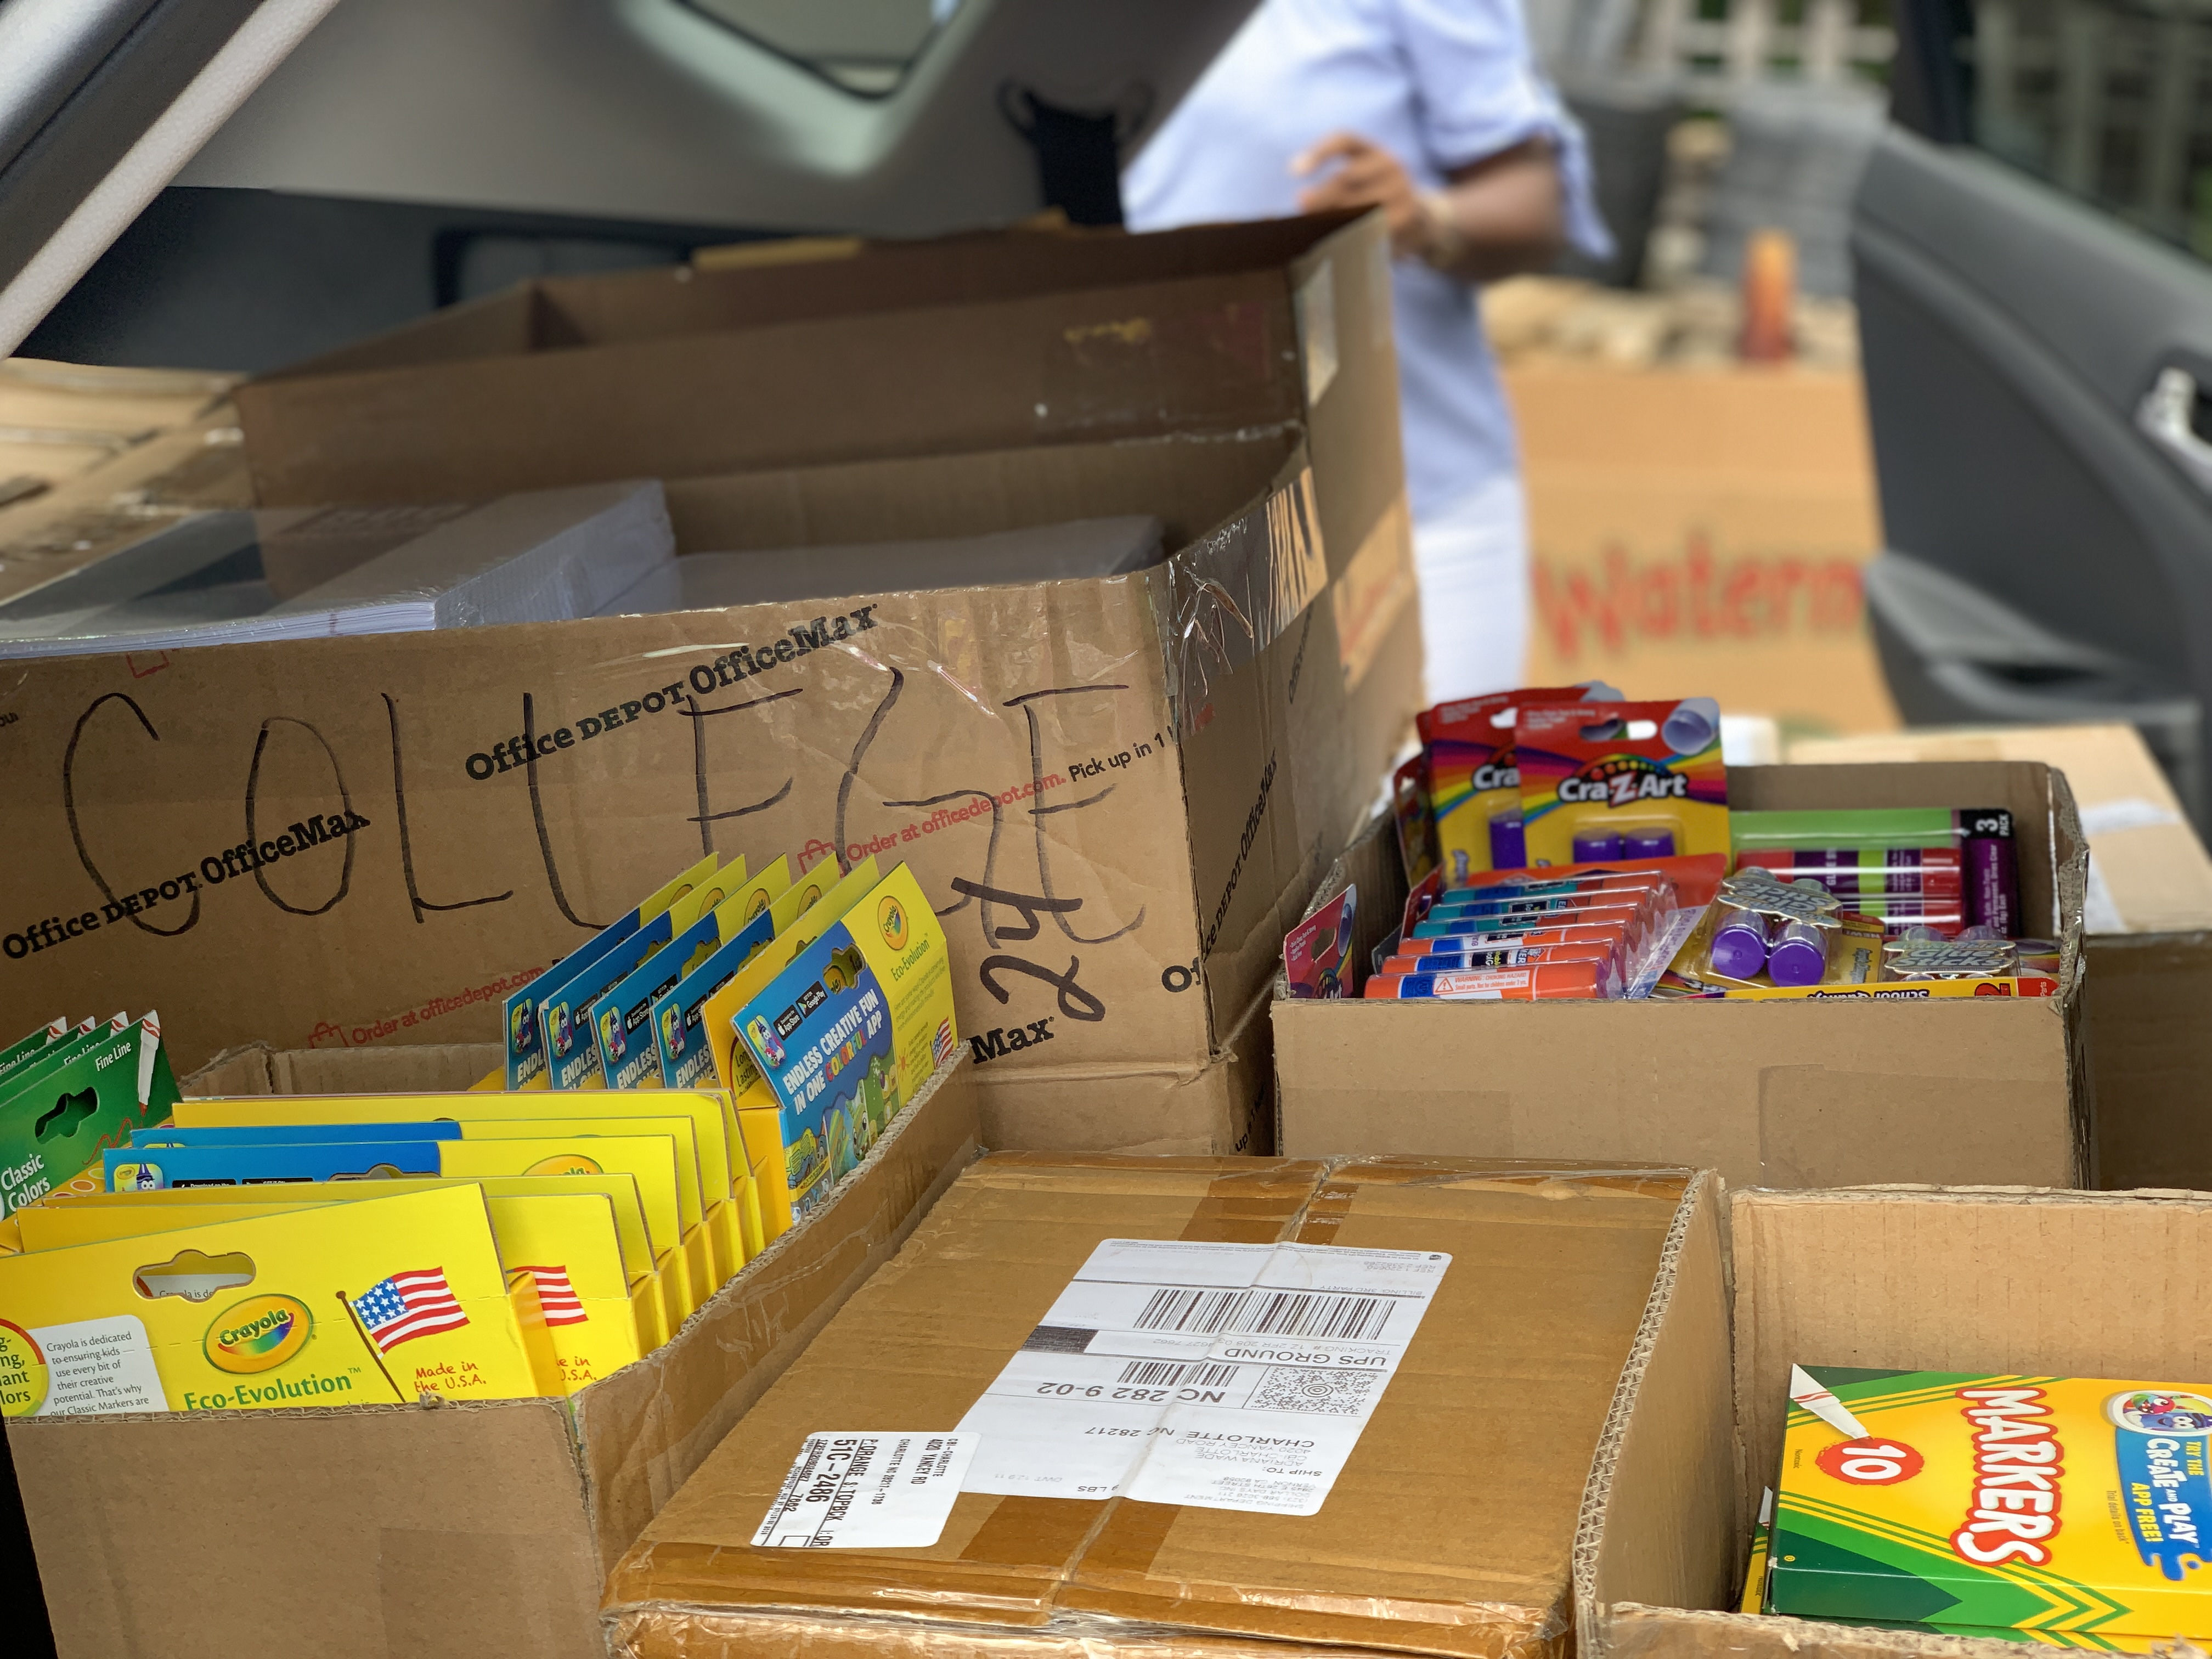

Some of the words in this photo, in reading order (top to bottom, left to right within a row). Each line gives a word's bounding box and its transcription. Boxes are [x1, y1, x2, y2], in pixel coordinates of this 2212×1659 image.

[465, 725, 576, 780] Office
[577, 680, 686, 741] DEPOT
[689, 603, 879, 695] OfficeMax
[847, 827, 897, 861] Order
[901, 826, 919, 843] at
[1069, 757, 1106, 783] Pick
[1108, 751, 1132, 771] up
[1133, 742, 1152, 758] in
[1154, 732, 1165, 748] 1
[1976, 819, 1998, 832] 3
[1999, 814, 2009, 837] PACK
[3, 911, 101, 959] Office
[105, 872, 202, 924] DEPOT
[201, 810, 371, 885] OfficeMax
[1216, 853, 1243, 932] DEPOT
[352, 1019, 398, 1044] Order
[401, 1011, 420, 1028] at
[782, 1046, 823, 1095] ENDLESS
[820, 1006, 863, 1056] CREATIVE
[858, 989, 879, 1013] FUN
[95, 1052, 114, 1071] Fine
[114, 1041, 132, 1061] Line
[561, 1043, 597, 1087] ENDLES
[794, 1092, 806, 1115] IN
[806, 1074, 826, 1102] ONE
[825, 1028, 867, 1082] COLORFUL
[866, 1010, 882, 1039] APP
[1, 1153, 45, 1191] Classic
[8, 1176, 50, 1212] Colors
[219, 1309, 289, 1346] Crayola
[47, 1340, 80, 1353] Crayola
[81, 1339, 88, 1347] is
[89, 1331, 132, 1346] dedicated
[1153, 1338, 1182, 1346] 7662
[1324, 1345, 1391, 1355] TRACKING
[52, 1357, 61, 1365] to
[64, 1350, 100, 1364] ensuring
[102, 1347, 120, 1358] kids
[574, 1356, 591, 1367] in
[1224, 1347, 1331, 1364] GROUND
[1340, 1355, 1387, 1367] UPS
[56, 1369, 71, 1378] use
[72, 1365, 97, 1378] every
[98, 1362, 110, 1371] bit
[112, 1359, 121, 1370] of
[415, 1362, 456, 1380] Made
[461, 1361, 479, 1373] in
[58, 1380, 78, 1390] their
[80, 1375, 114, 1387] creative
[413, 1380, 440, 1393] the
[445, 1374, 487, 1390] U.S.A.
[1036, 1381, 1104, 1398] 9-02
[54, 1390, 95, 1407] potential.
[95, 1386, 123, 1399] That's
[124, 1384, 142, 1396] why
[1111, 1387, 1170, 1402] 282
[1176, 1388, 1226, 1403] NC
[67, 1403, 97, 1415] Classic
[99, 1398, 133, 1412] Markers
[135, 1396, 149, 1406] are
[1084, 1426, 1142, 1437] 28217
[1186, 1431, 1315, 1448] CHARLOTTE
[889, 1438, 911, 1465] CHARLOTTE
[925, 1438, 944, 1451] 4020
[1176, 1438, 1217, 1447] ROAD
[1219, 1442, 1274, 1452] YANCEY
[2186, 1441, 2202, 1457] TRY
[915, 1453, 938, 1475] YANCEY
[932, 1438, 959, 1477] CBI-CHARLOTTE
[1195, 1453, 1238, 1462] WADE
[1242, 1457, 1304, 1467] ADRIANA
[1793, 1448, 1803, 1469] Nontoxic
[1840, 1444, 1907, 1481] 10
[2146, 1437, 2188, 1488] CREATE
[1952, 1387, 2062, 1565] MARKERS
[2187, 1459, 2204, 1476] THE
[910, 1476, 928, 1485] RD
[786, 1493, 804, 1512] 7662
[2106, 1490, 2118, 1501] Trial
[2131, 1482, 2152, 1506] APP
[2165, 1488, 2179, 1502] AND
[2108, 1502, 2121, 1520] details
[2135, 1509, 2164, 1542] FREE!
[2158, 1503, 2199, 1544] PLAY
